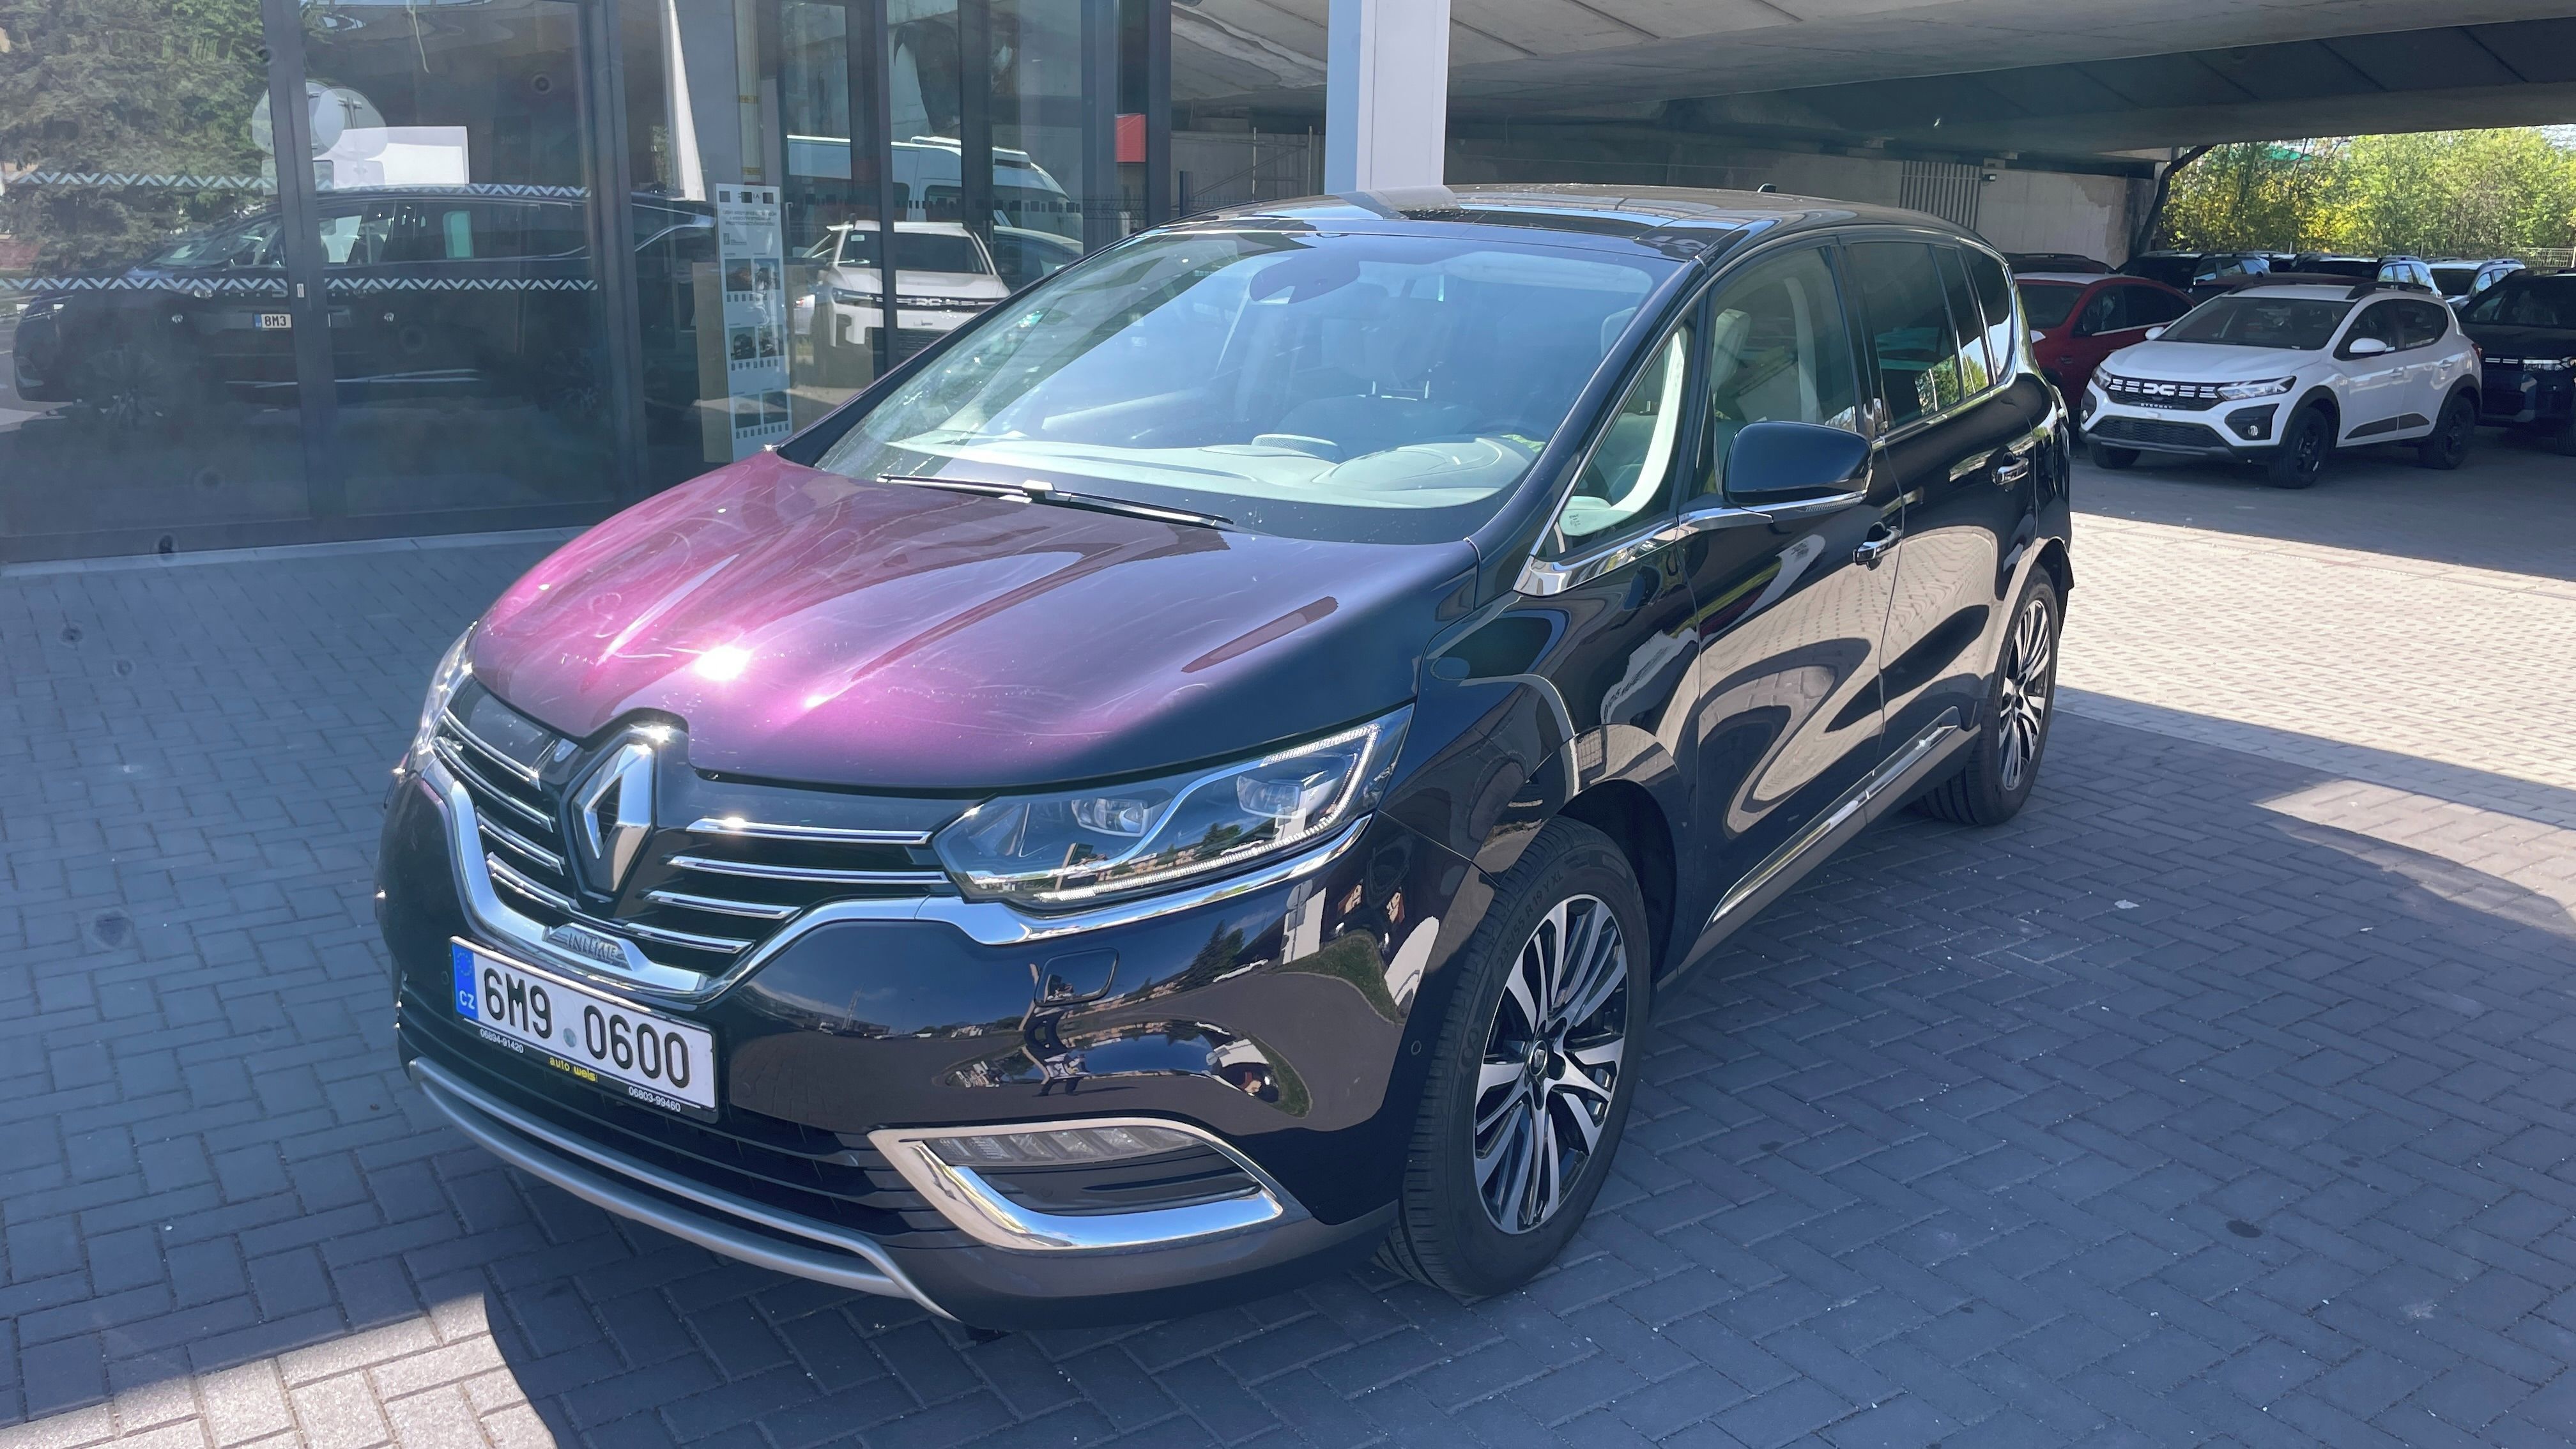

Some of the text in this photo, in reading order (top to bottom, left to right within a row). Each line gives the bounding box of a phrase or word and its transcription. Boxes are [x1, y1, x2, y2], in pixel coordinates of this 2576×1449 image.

[264, 316, 287, 326] 8M3
[459, 990, 475, 1010] CZ
[484, 968, 691, 1089] 6M9 0600
[549, 1057, 571, 1072] auto
